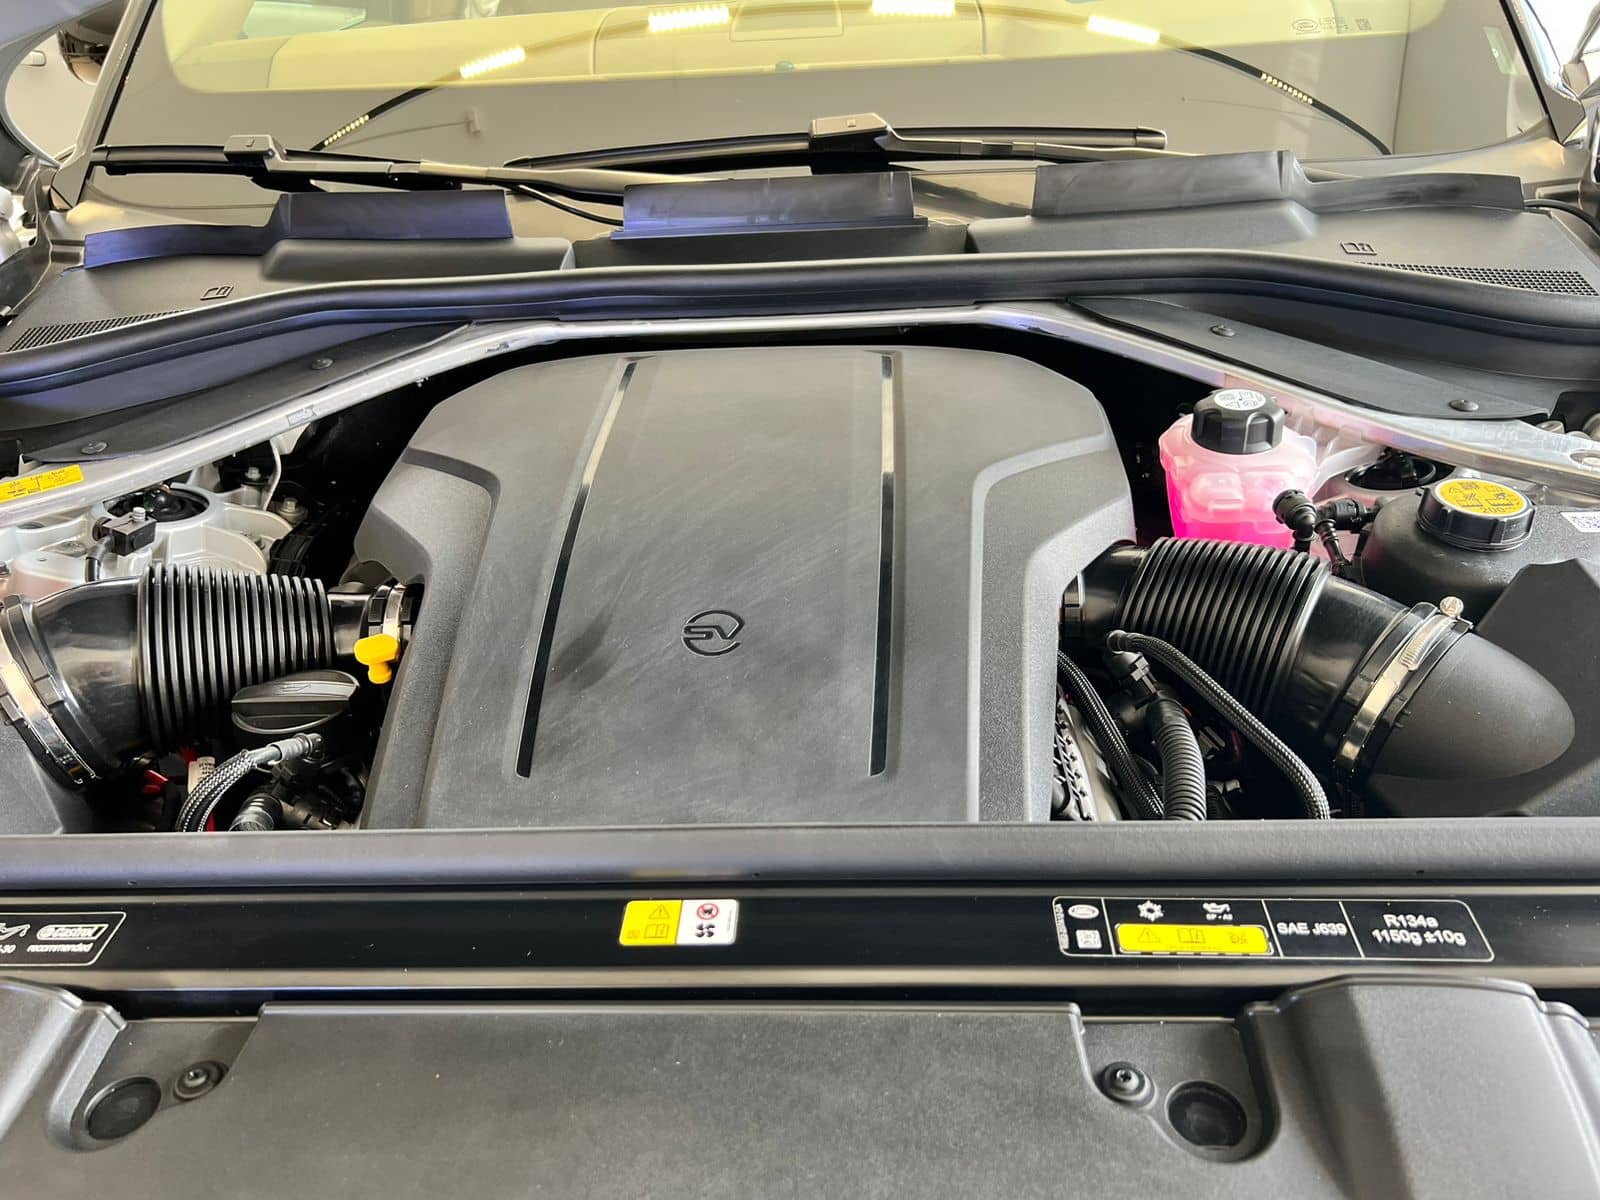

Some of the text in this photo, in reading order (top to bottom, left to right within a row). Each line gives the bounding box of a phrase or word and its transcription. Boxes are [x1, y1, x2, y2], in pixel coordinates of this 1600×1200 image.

[1383, 914, 1438, 928] R134a
[1276, 922, 1348, 936] SAE J639
[1371, 929, 1467, 946] 1150g ±10g
[27, 943, 93, 952] recommended
